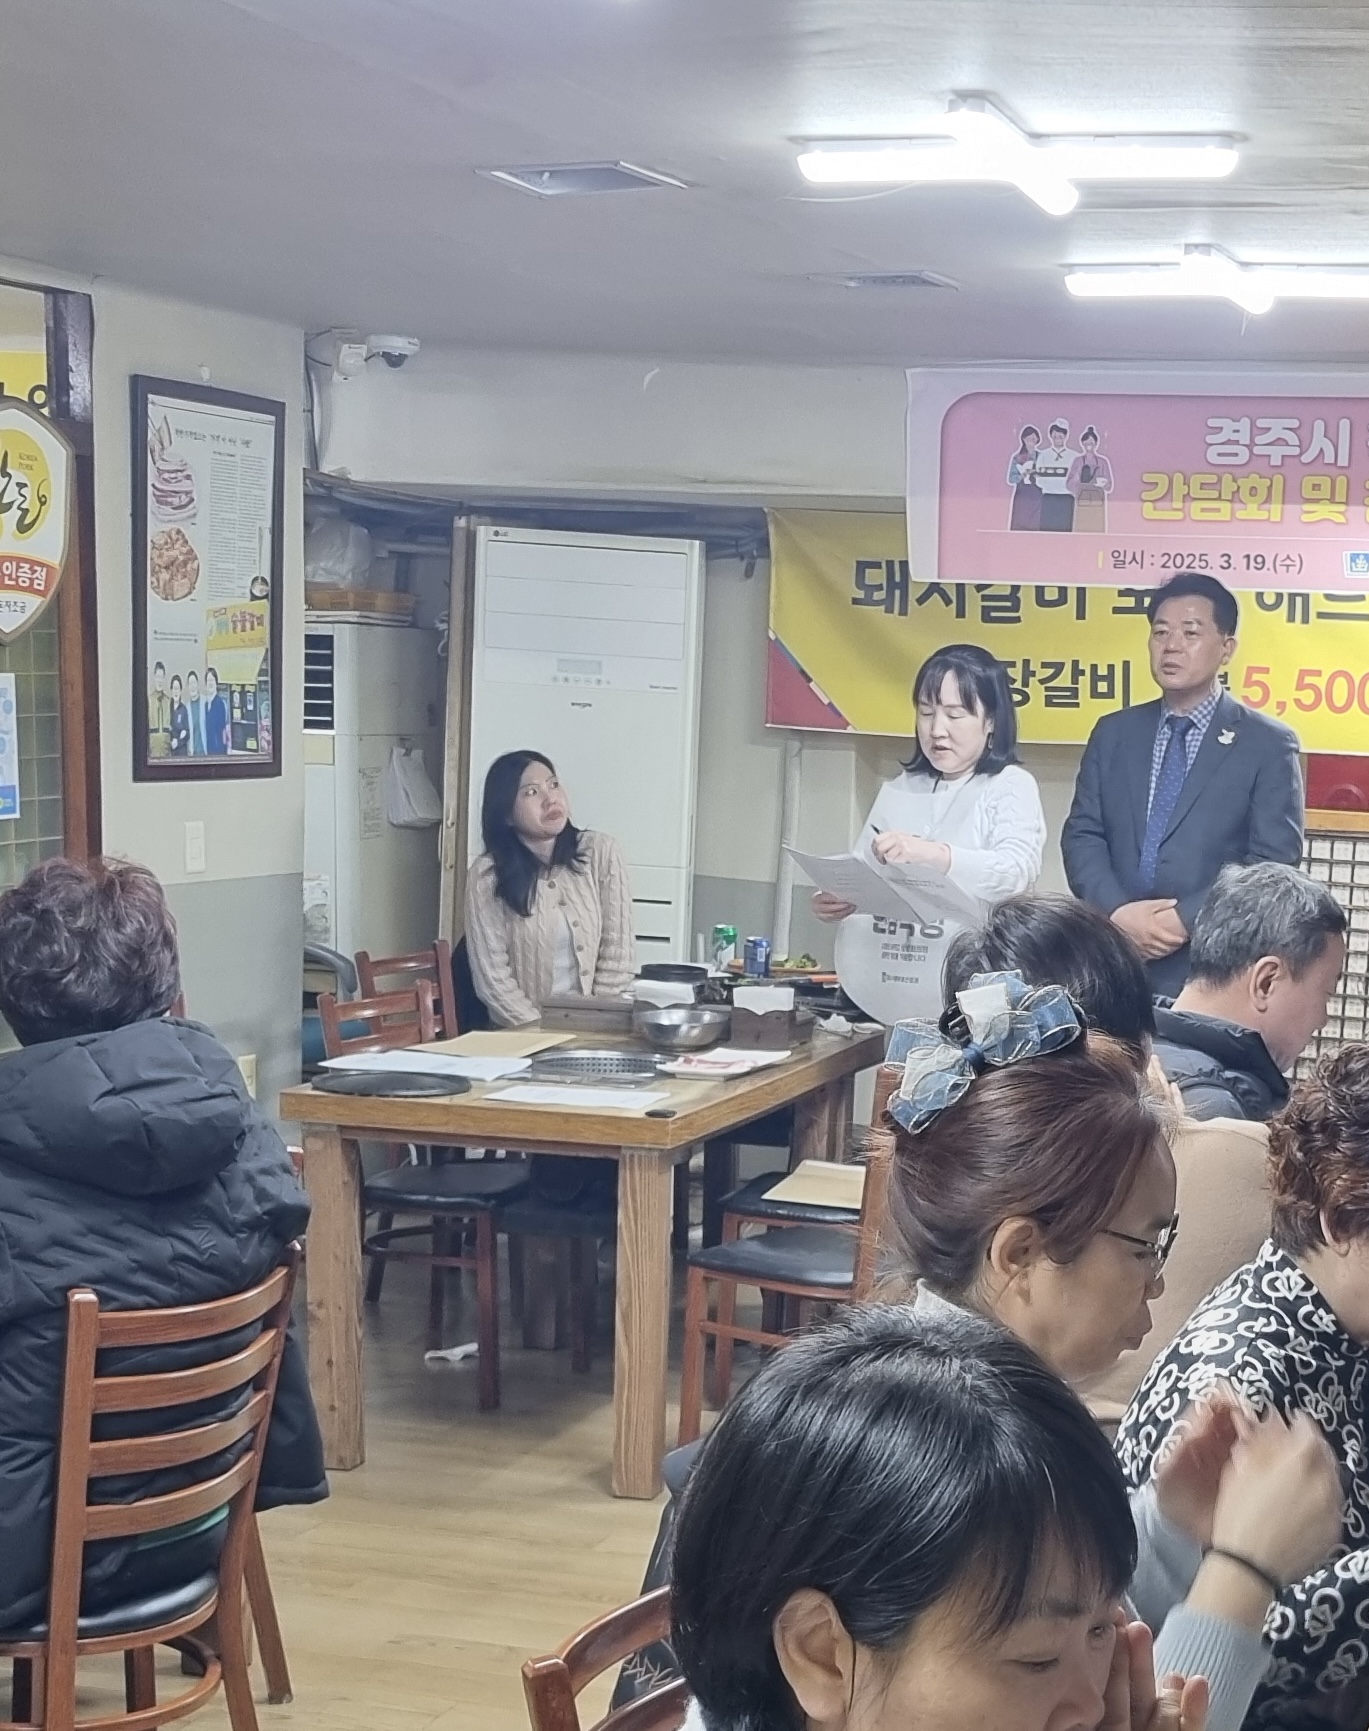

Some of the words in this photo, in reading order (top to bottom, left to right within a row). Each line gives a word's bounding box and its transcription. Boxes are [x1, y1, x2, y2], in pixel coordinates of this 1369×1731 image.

[1205, 416, 1350, 467] 경주시
[1140, 472, 1285, 523] 간담회
[1299, 475, 1348, 524] 및
[1111, 550, 1145, 570] 일시
[1160, 552, 1213, 570] 2025.
[1219, 553, 1237, 571] 3.
